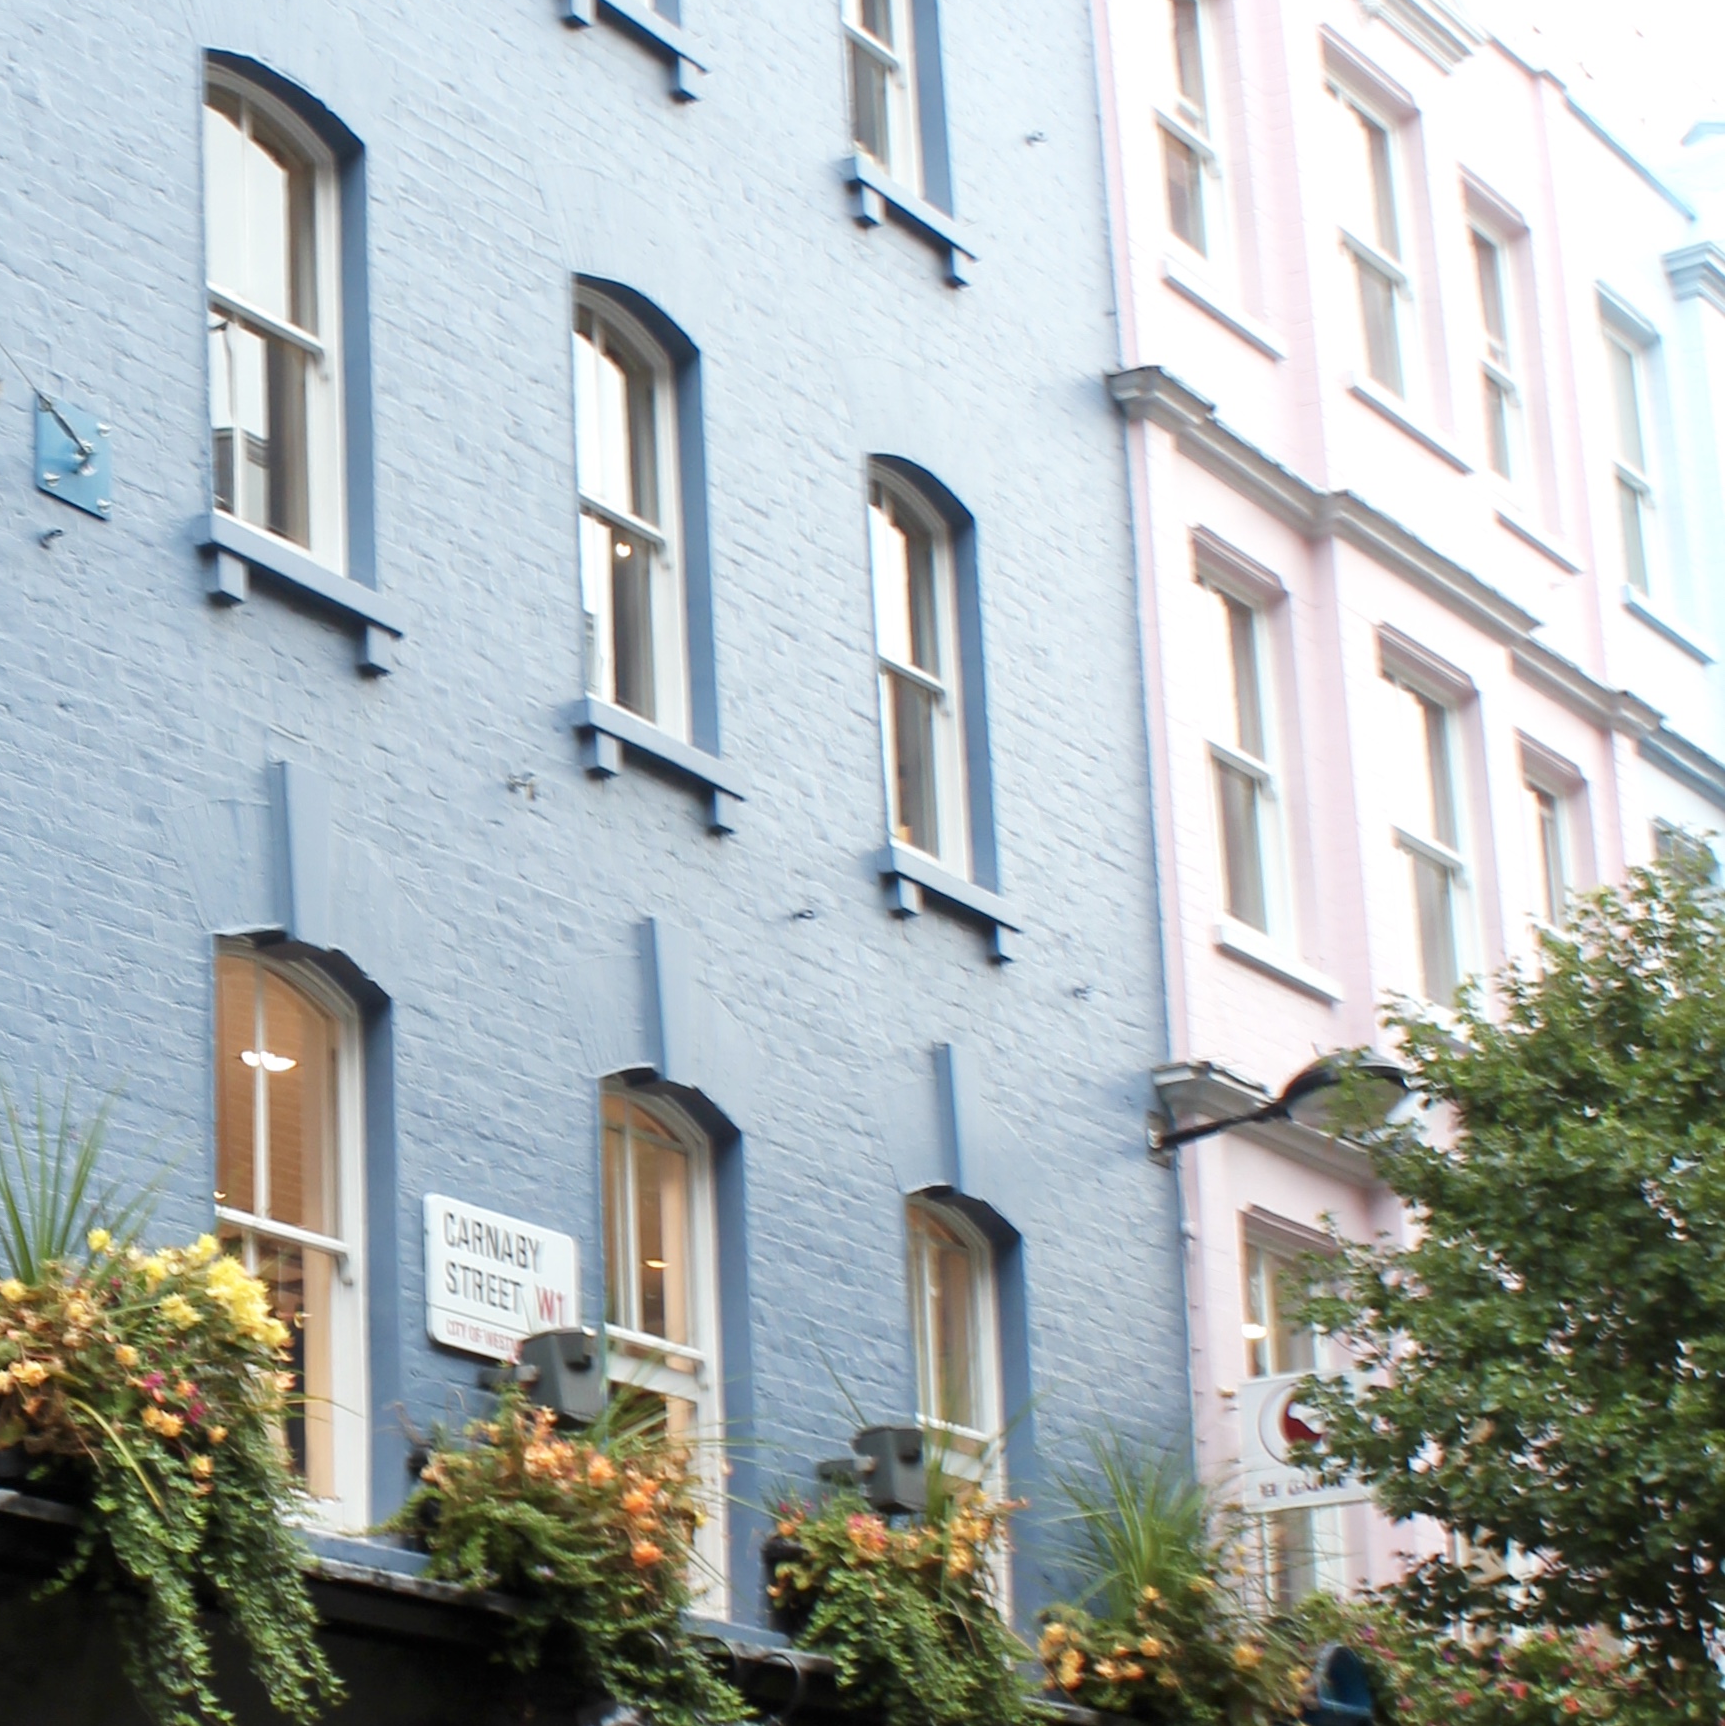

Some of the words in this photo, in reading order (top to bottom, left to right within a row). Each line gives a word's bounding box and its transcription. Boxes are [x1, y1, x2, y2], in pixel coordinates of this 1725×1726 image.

[442, 1208, 542, 1273] CARNABY
[444, 1259, 522, 1314] STREET
[534, 1282, 566, 1328] W1
